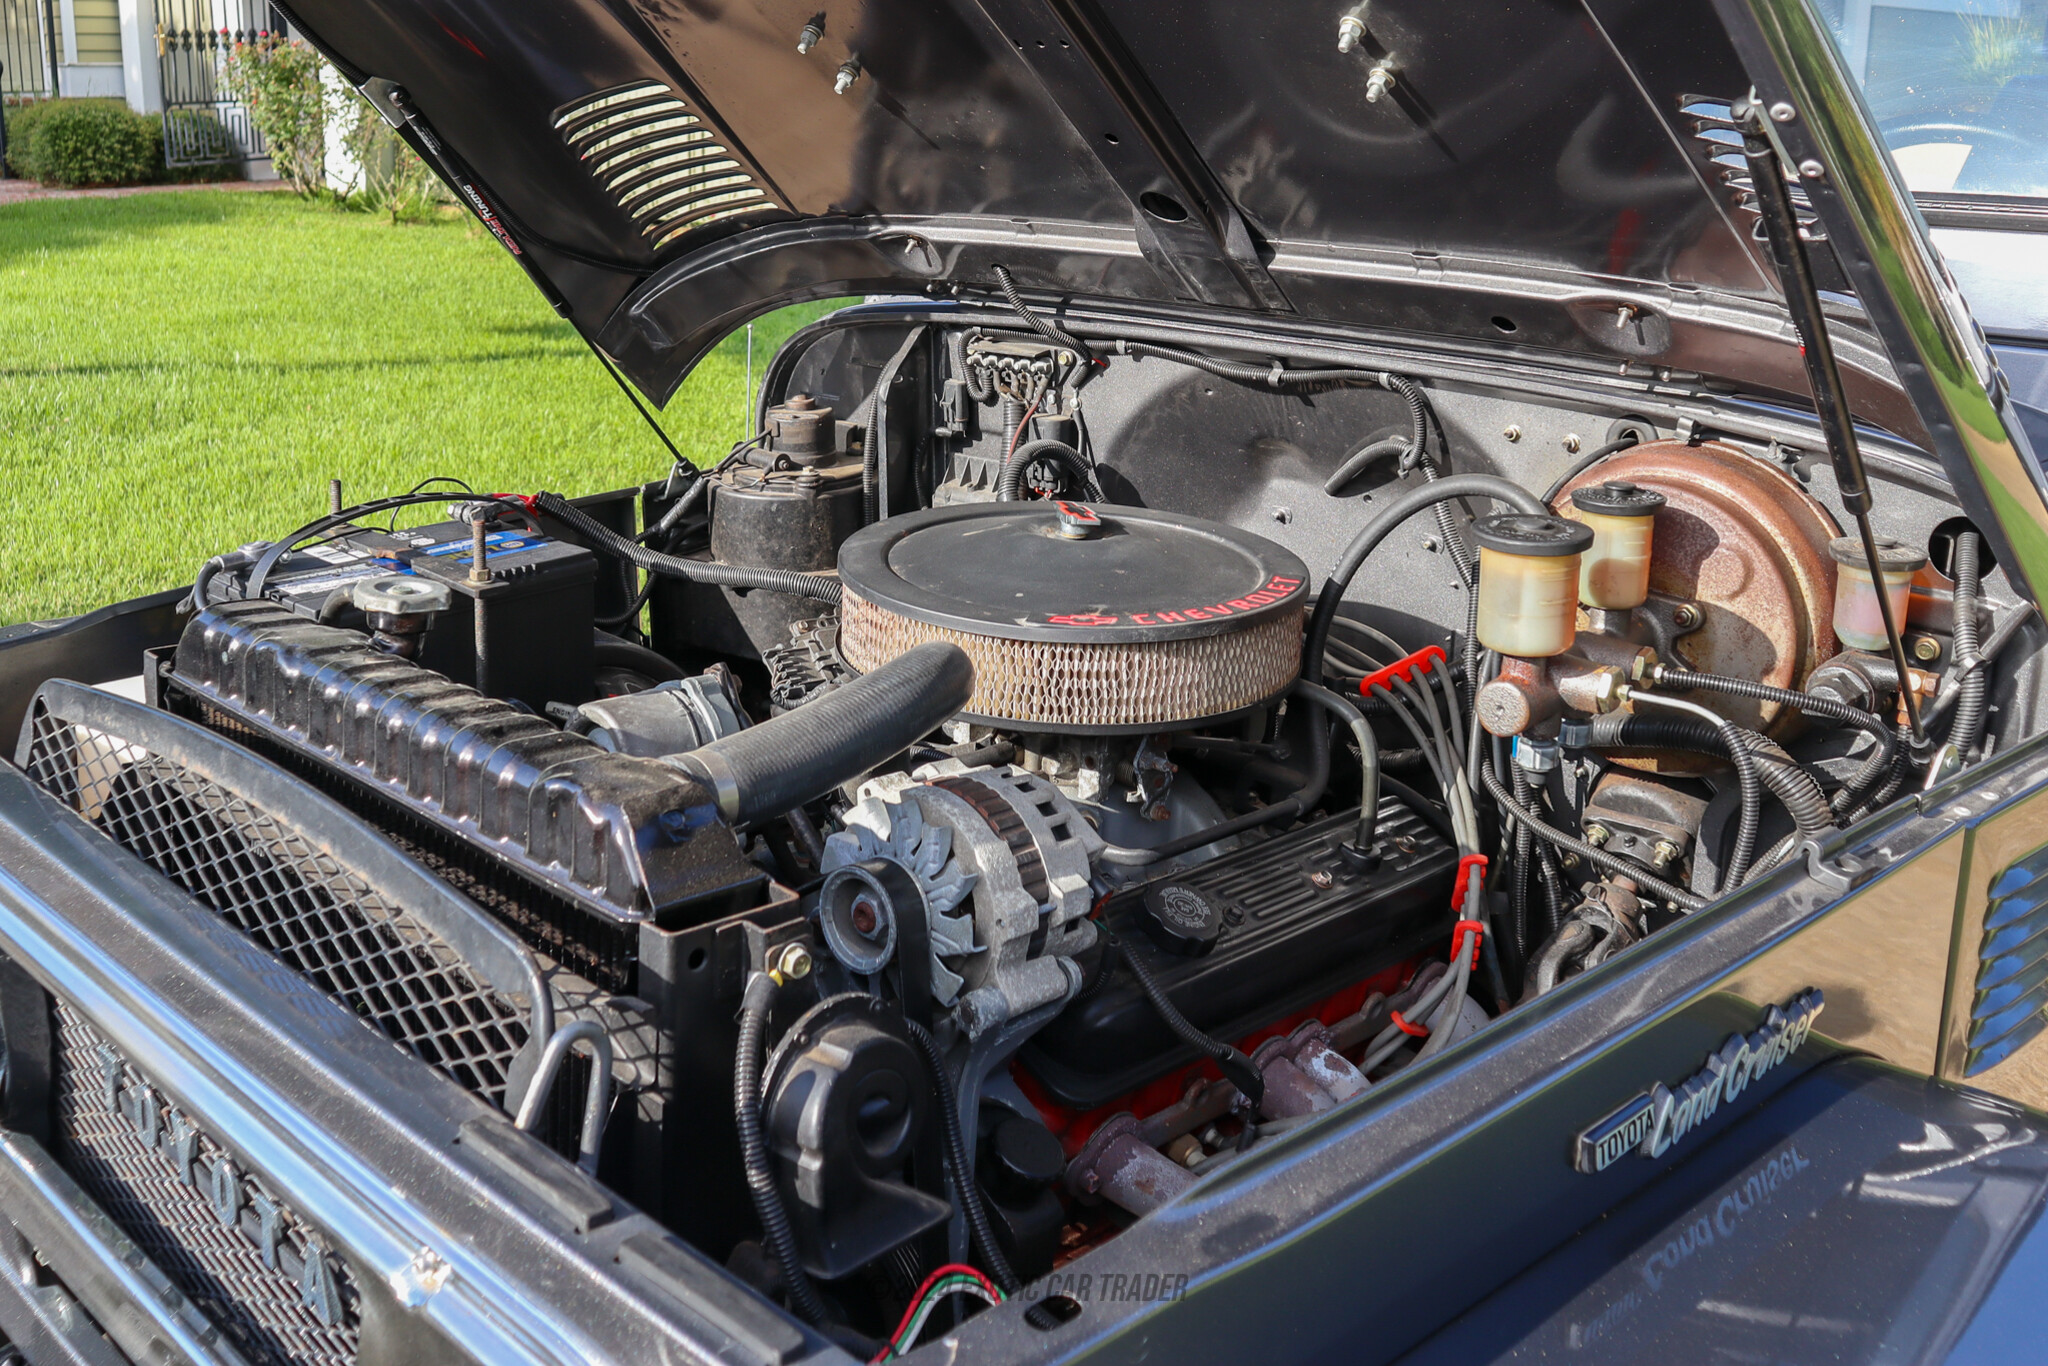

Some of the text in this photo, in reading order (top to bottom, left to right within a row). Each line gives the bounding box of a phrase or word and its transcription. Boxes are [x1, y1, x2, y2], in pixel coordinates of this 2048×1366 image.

[463, 184, 493, 219] TUNING
[1132, 575, 1301, 625] CHEVROLET
[1598, 992, 1825, 1169] TOYOTA Land Cruiser
[98, 1042, 343, 1327] TOYOTA
